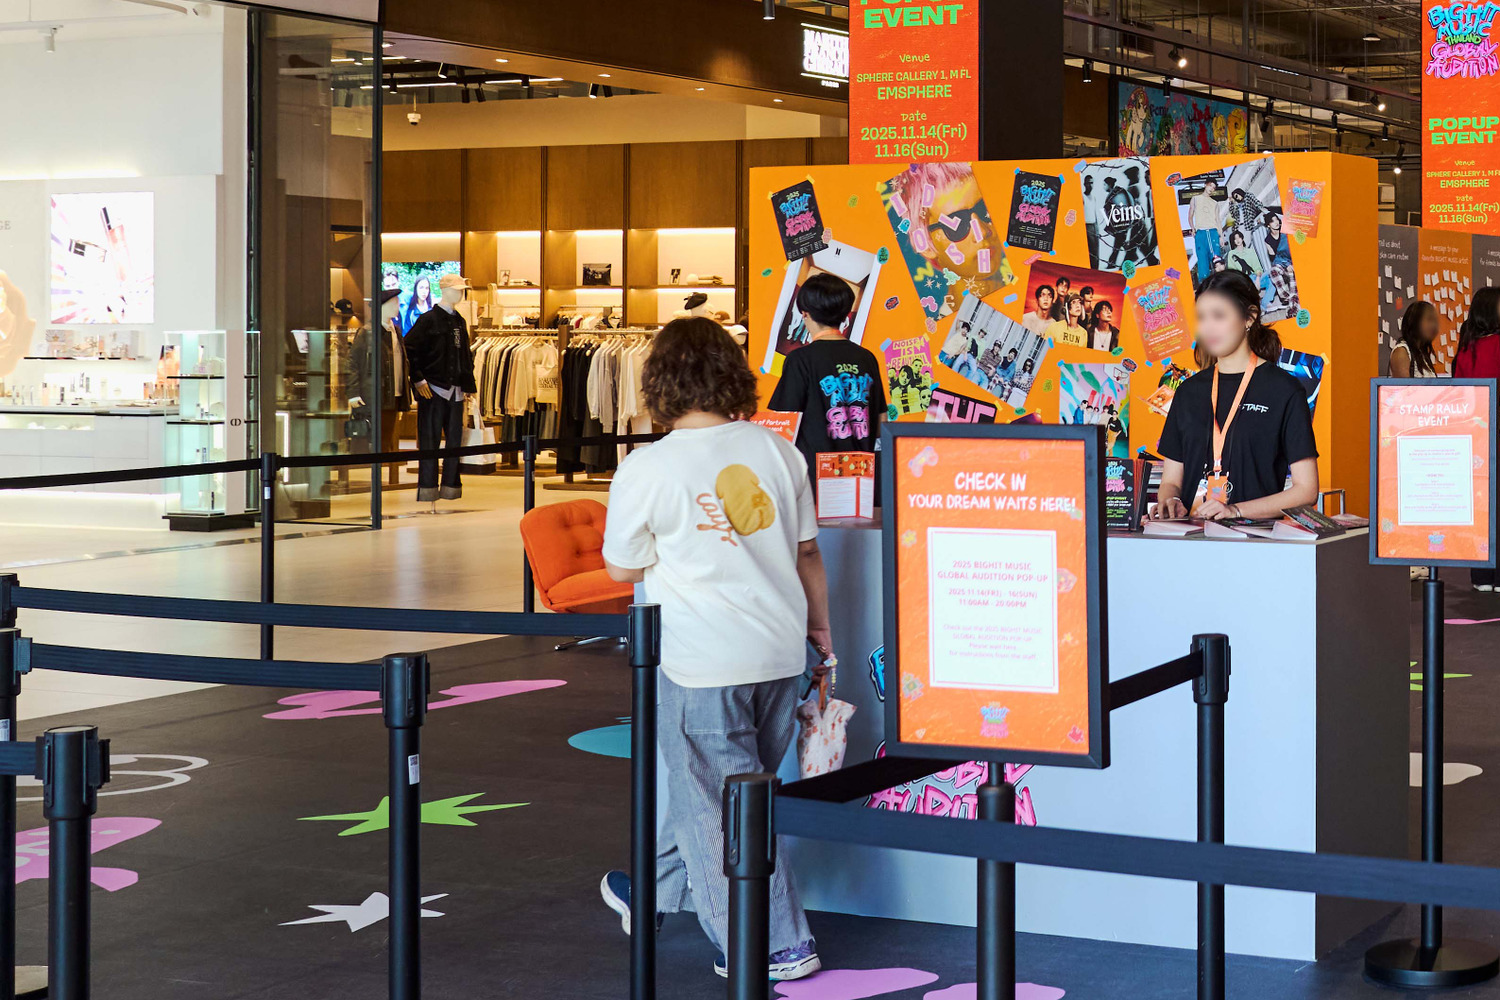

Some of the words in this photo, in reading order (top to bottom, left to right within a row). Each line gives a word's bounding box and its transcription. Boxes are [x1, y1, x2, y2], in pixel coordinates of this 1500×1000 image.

[864, 5, 963, 28] EVENT
[1437, 20, 1492, 42] MUSIC
[1445, 34, 1481, 45] THAILAND
[1431, 39, 1499, 59] GLOBAL
[899, 54, 930, 63] Venue
[1426, 54, 1500, 79] AUDITION
[857, 72, 893, 82] SPHERE
[896, 71, 938, 81] GALLERY
[950, 70, 958, 79] M
[960, 69, 971, 78] FL
[878, 85, 952, 100] EMSPHERE
[901, 111, 927, 121] Date
[1429, 116, 1499, 130] POPUP
[861, 123, 967, 141] 2025.11.14(Fri)
[1431, 131, 1496, 145] EVENT
[875, 141, 949, 159] 11.16(Sun)
[1440, 179, 1489, 188] EMSPHERE
[1100, 201, 1143, 227] Veins
[1430, 202, 1500, 213] 2025.11.14(Fri)
[1062, 332, 1080, 344] RUN
[1400, 404, 1434, 414] STAMP
[1437, 403, 1469, 414] RALLY
[1418, 416, 1449, 426] EVENT
[955, 472, 1007, 491] CHECK
[1011, 473, 1026, 491] IN
[908, 494, 943, 508] YOUR
[946, 495, 990, 509] DREAM
[994, 496, 1037, 511] WAITS
[1040, 497, 1076, 512] HERE!
[974, 561, 1002, 569] BIGHIT
[1005, 562, 1031, 570] MUSIC
[938, 571, 968, 579] GLOBAL
[972, 572, 1014, 581] AUDITION
